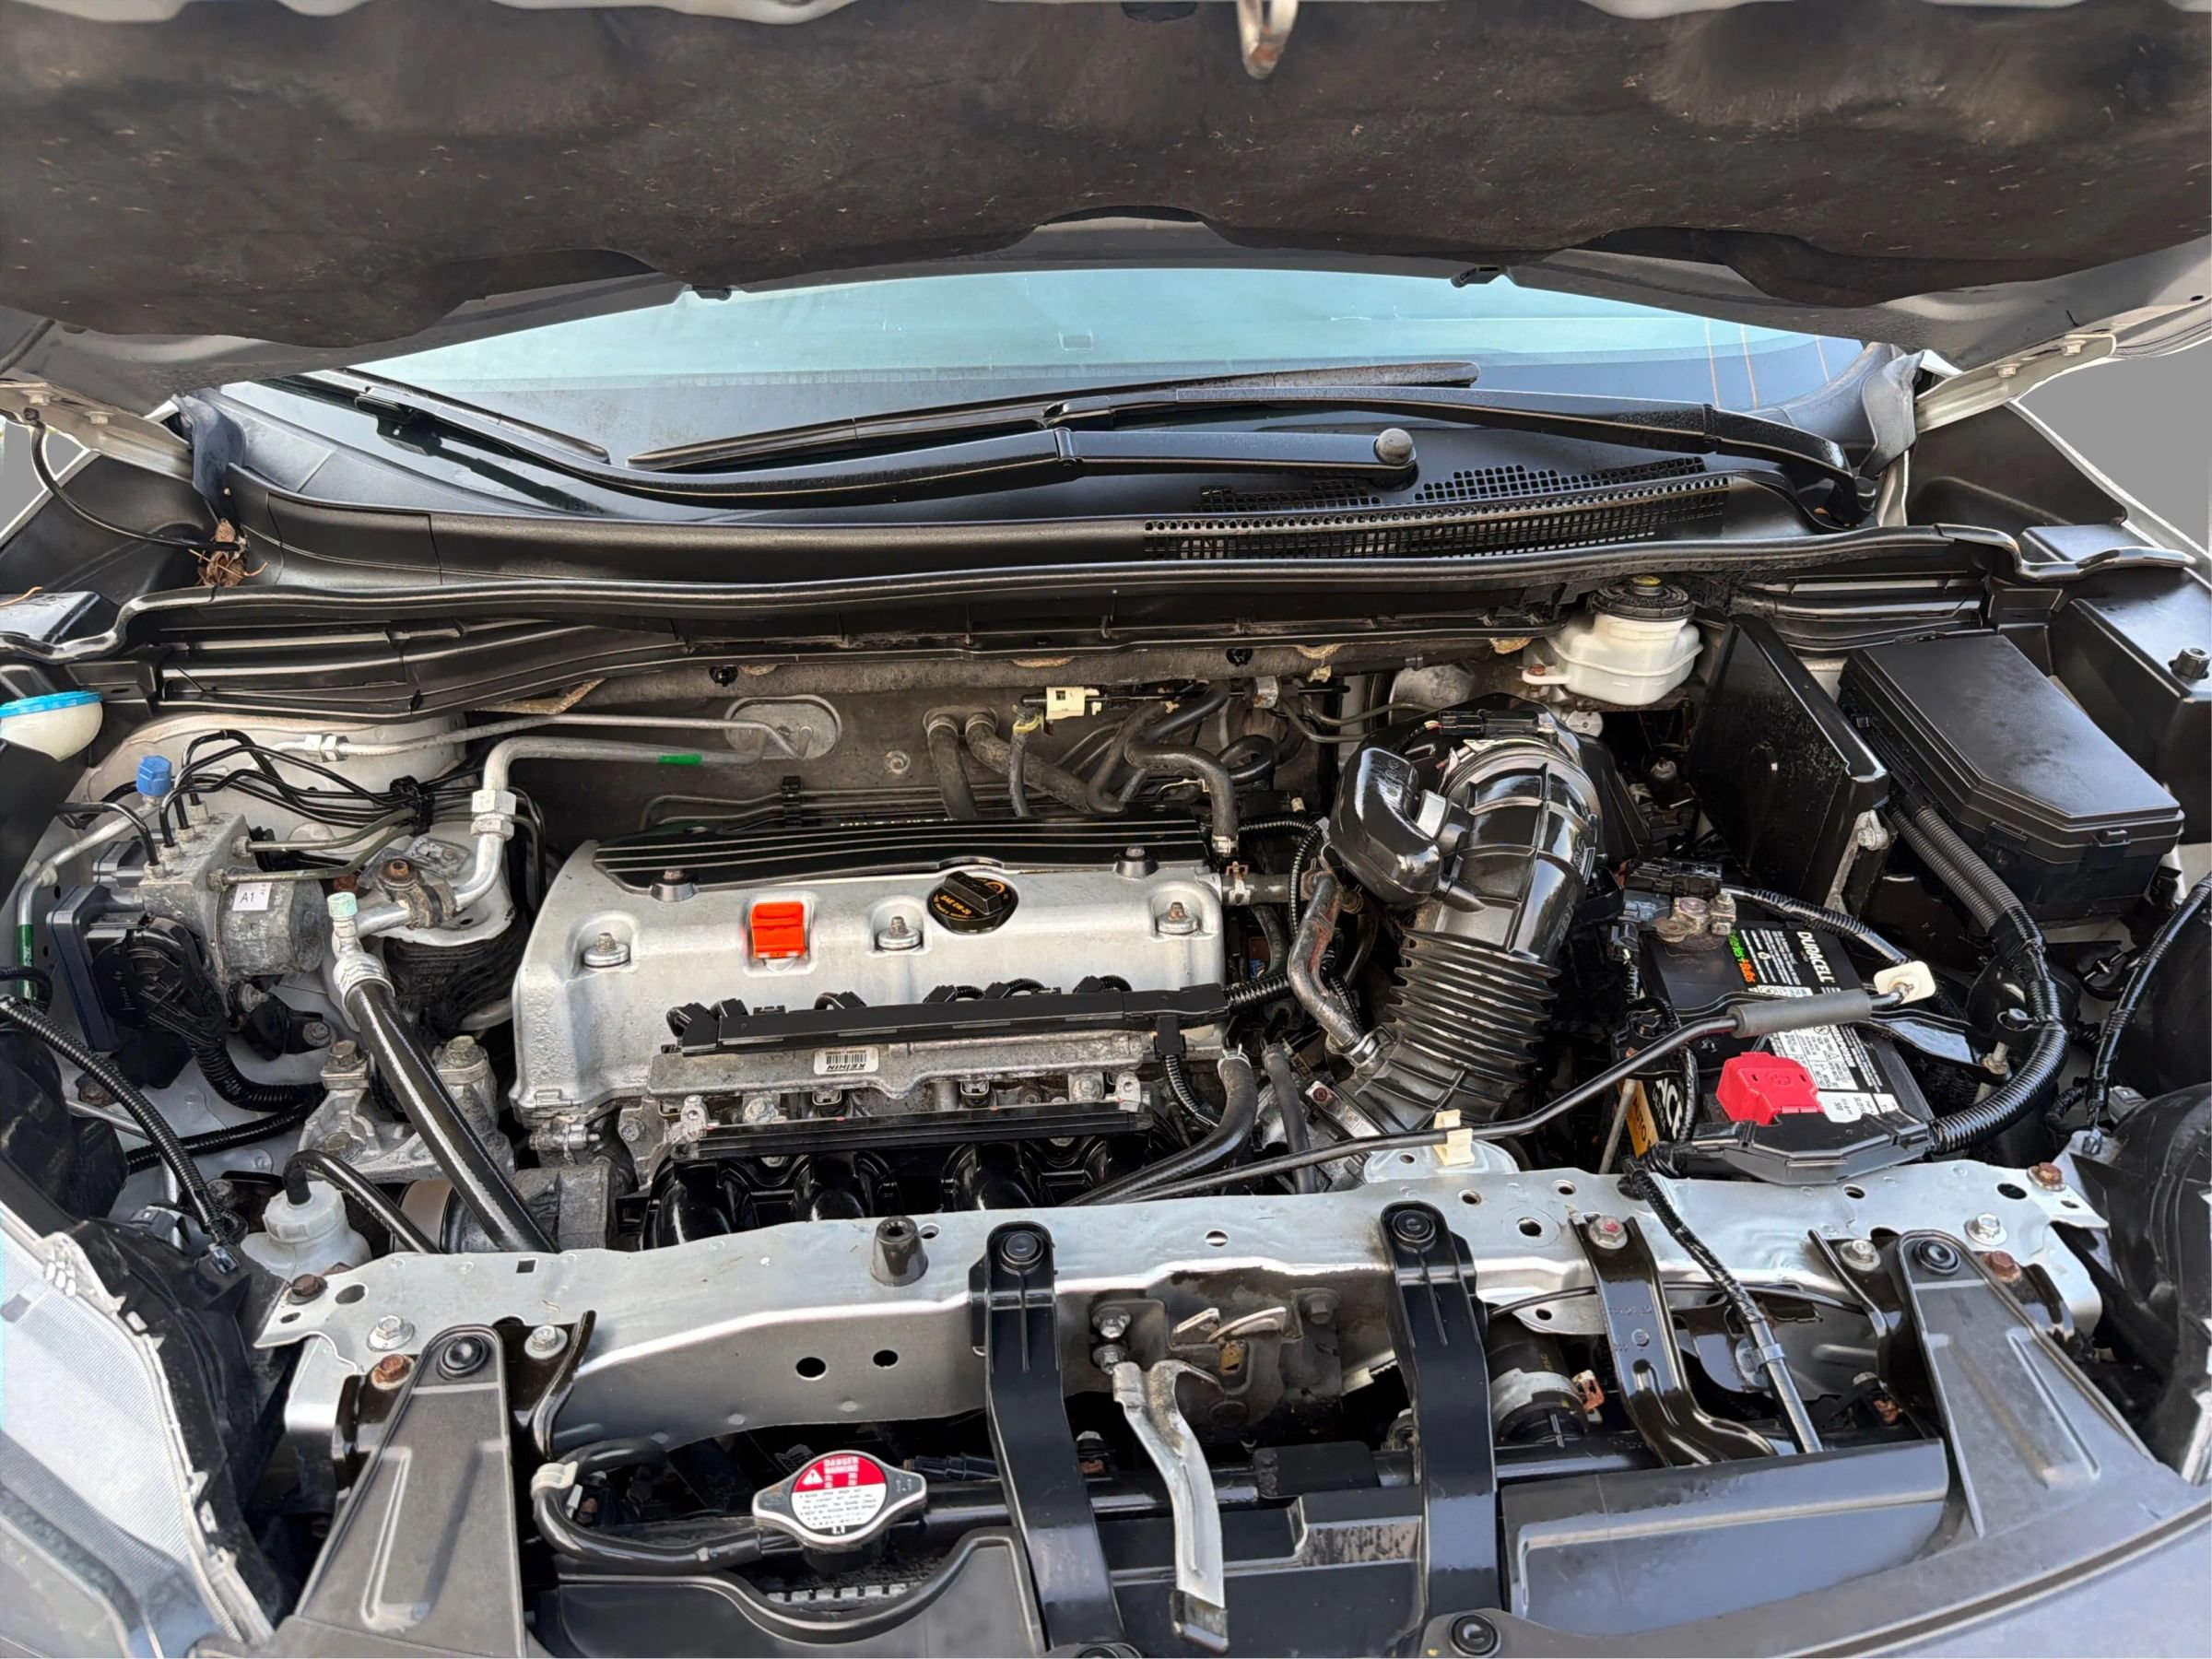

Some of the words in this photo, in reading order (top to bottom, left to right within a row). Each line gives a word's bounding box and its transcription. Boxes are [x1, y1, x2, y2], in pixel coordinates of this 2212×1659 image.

[240, 891, 254, 903] A1
[1796, 931, 1835, 983] DURACELL
[824, 1456, 859, 1468] DANGER
